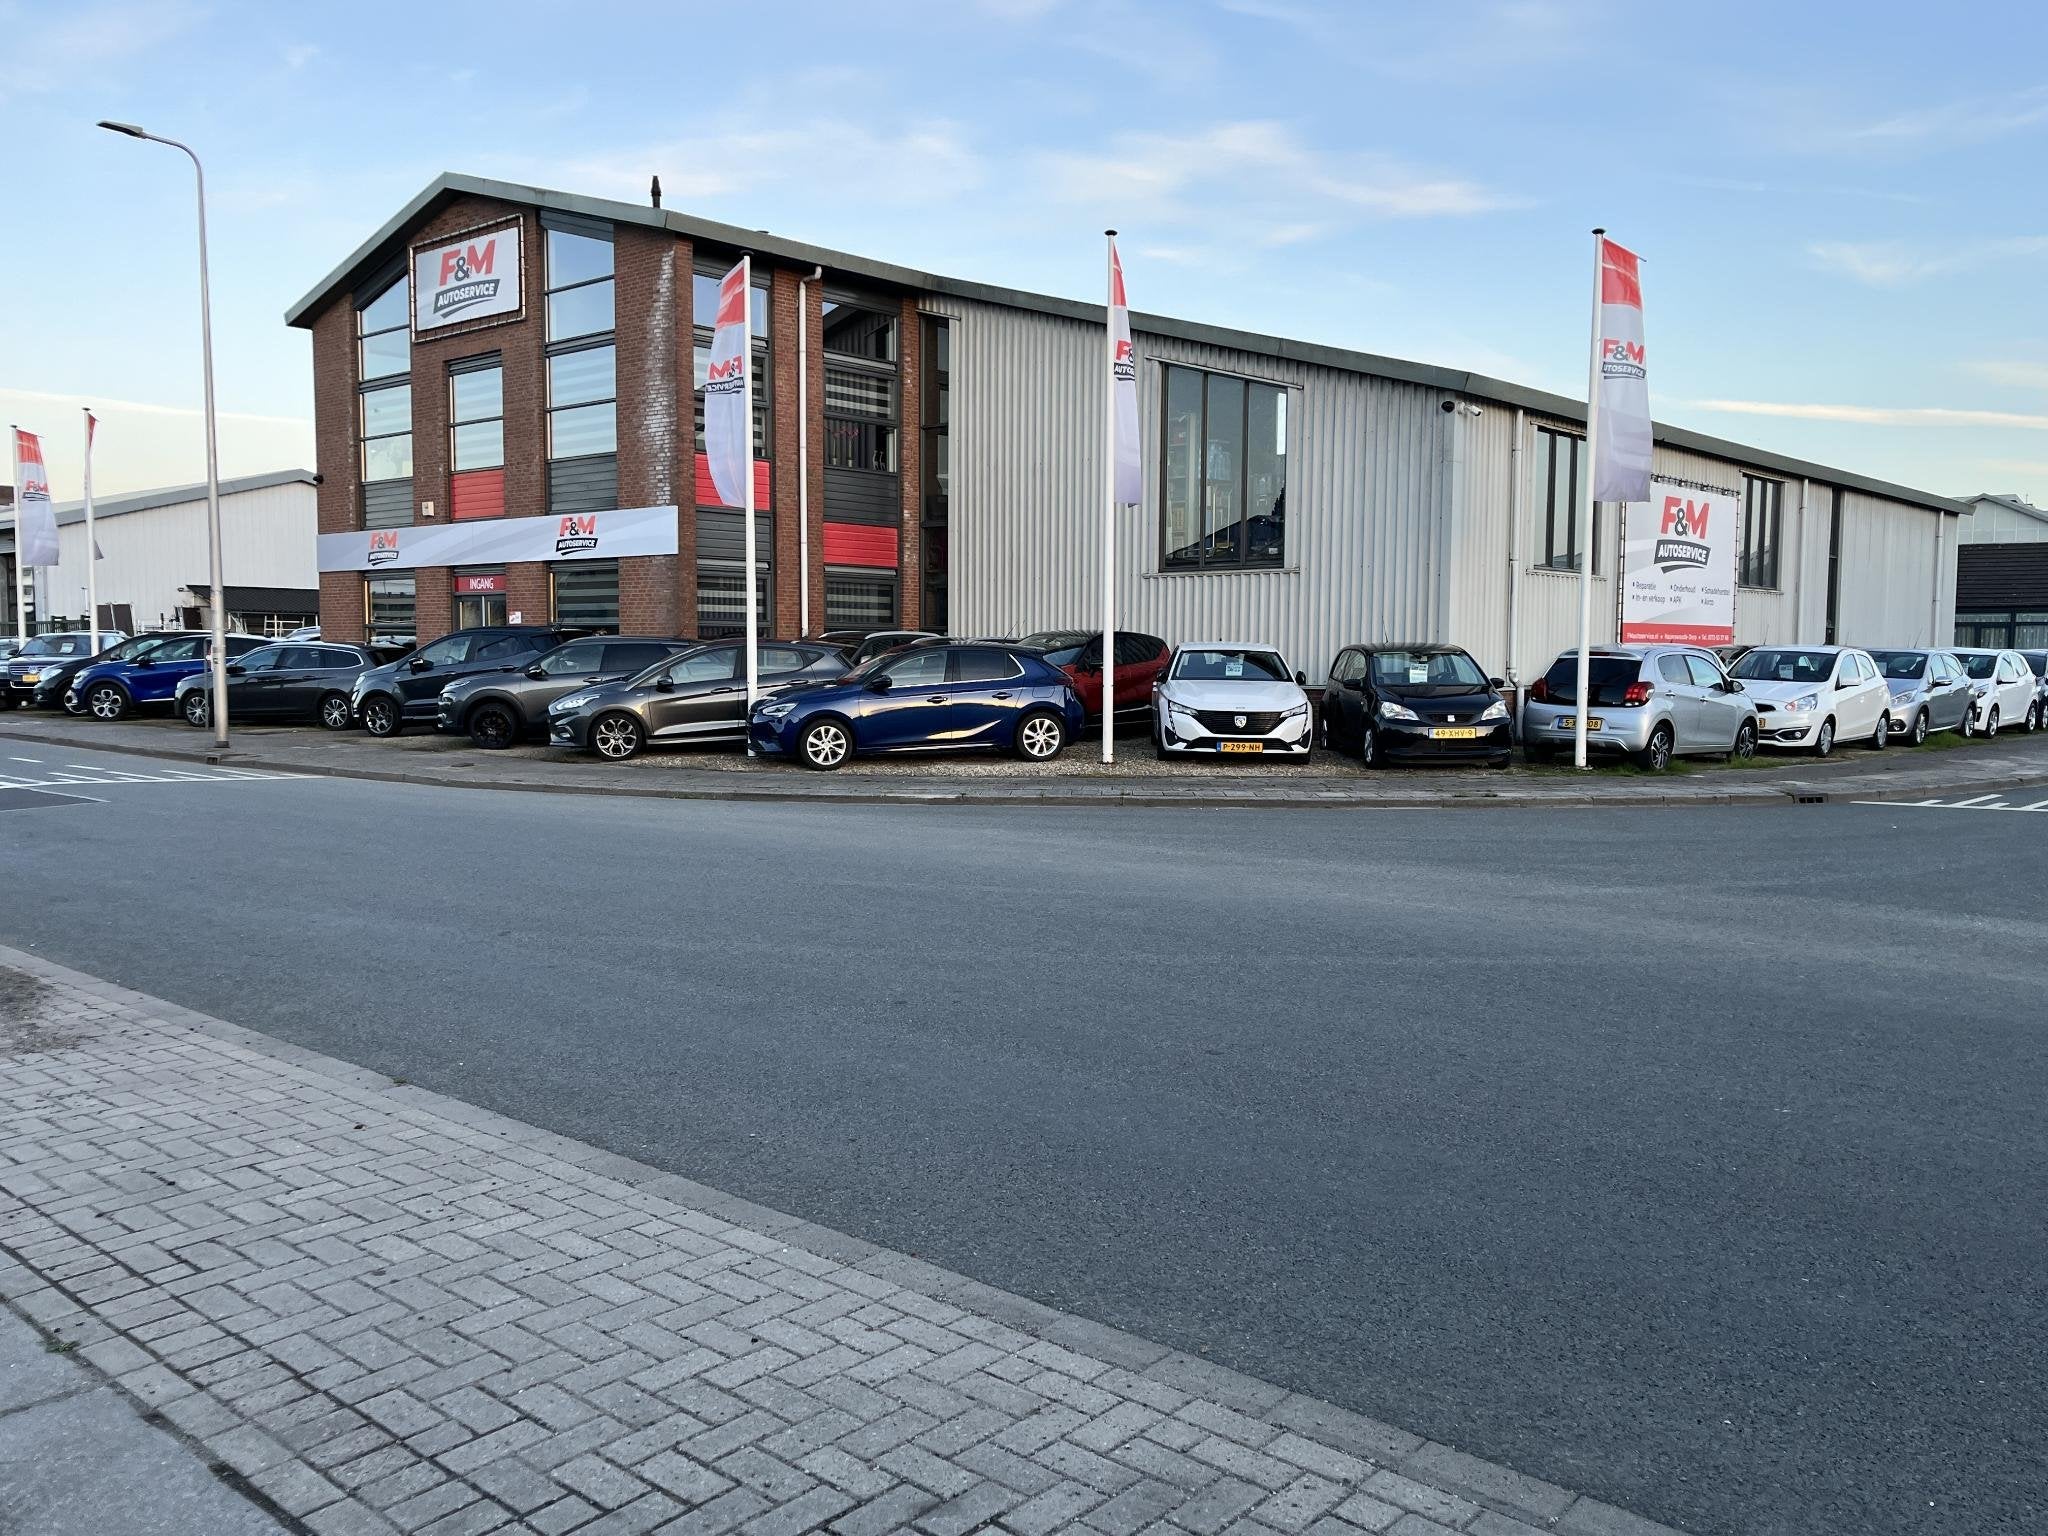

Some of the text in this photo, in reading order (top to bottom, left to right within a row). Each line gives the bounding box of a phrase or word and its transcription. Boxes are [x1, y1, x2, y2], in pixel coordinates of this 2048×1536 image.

[439, 239, 496, 287] F&M
[437, 282, 495, 307] AUTOSERVICE
[1603, 338, 1645, 365] F&M
[560, 515, 596, 537] F&M
[1660, 495, 1710, 539] F&M
[370, 531, 398, 550] F&M
[558, 540, 595, 549] AUTOSERVICE
[1657, 544, 1707, 562] AUTOSERVICE
[469, 577, 494, 590] INGANG
[1435, 729, 1473, 737] 49-XHV-9
[1223, 743, 1261, 752] P-299-NH
